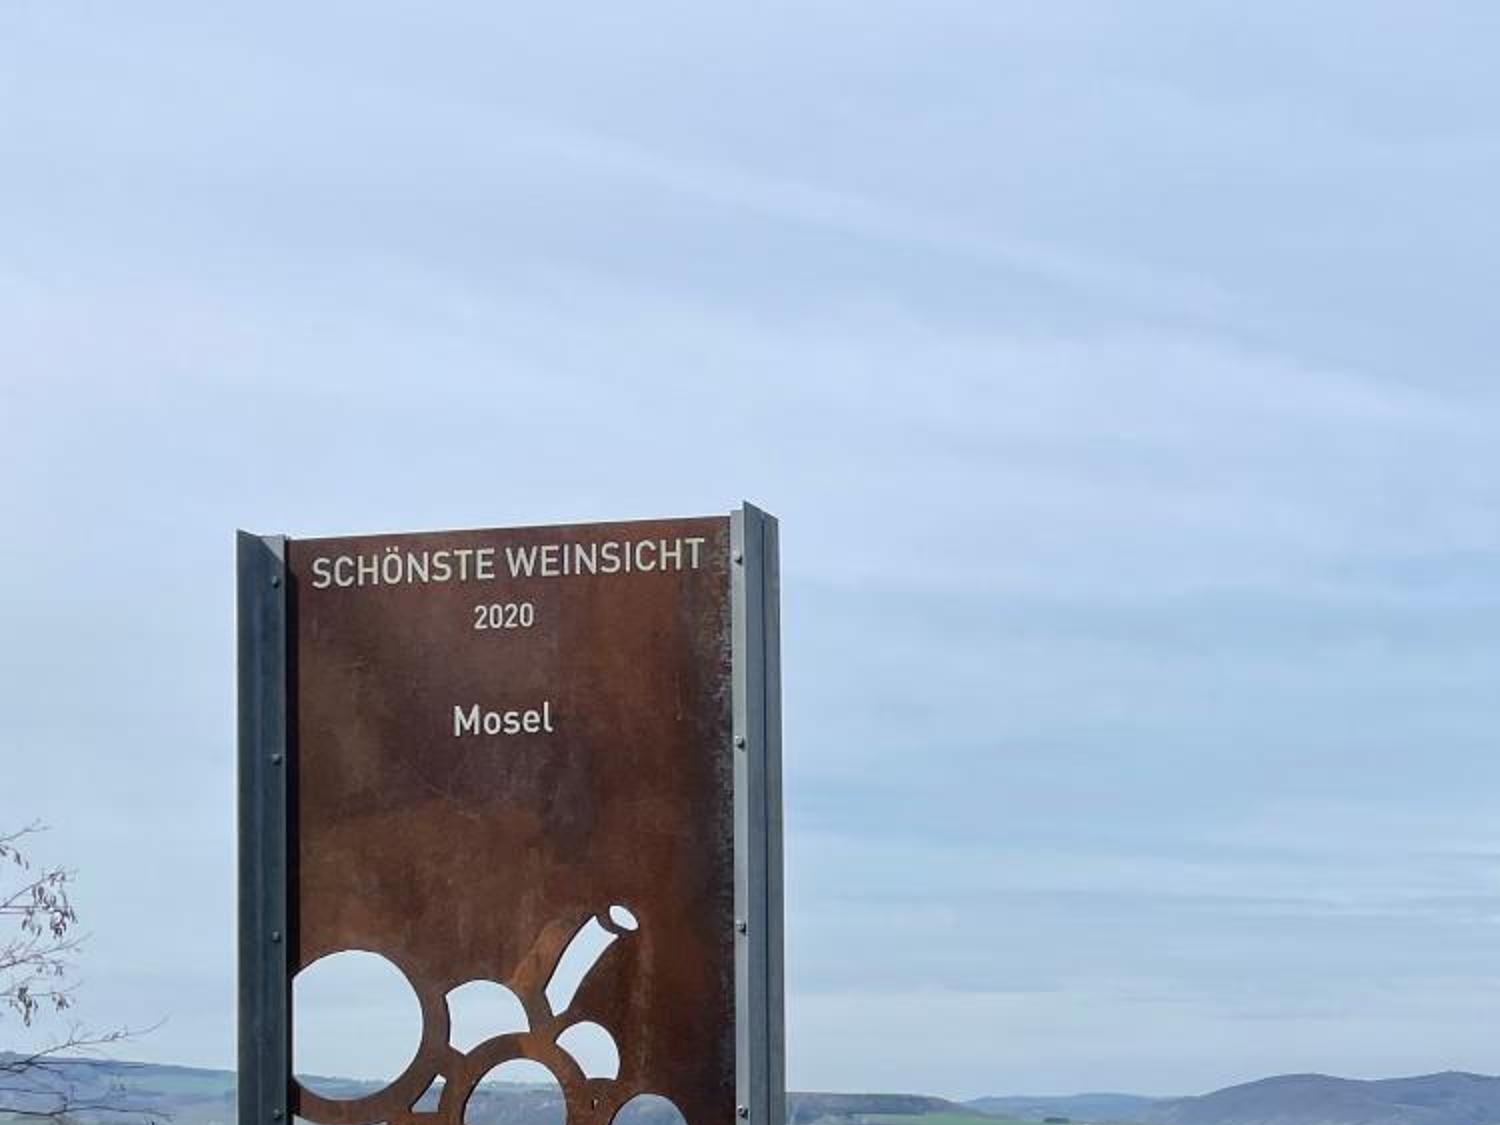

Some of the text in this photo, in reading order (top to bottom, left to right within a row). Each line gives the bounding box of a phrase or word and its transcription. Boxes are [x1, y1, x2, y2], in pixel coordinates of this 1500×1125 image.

[311, 537, 706, 589] SCHÖNSTE WEINSICHT
[473, 602, 535, 630] 2020
[452, 702, 554, 737] Mosel
